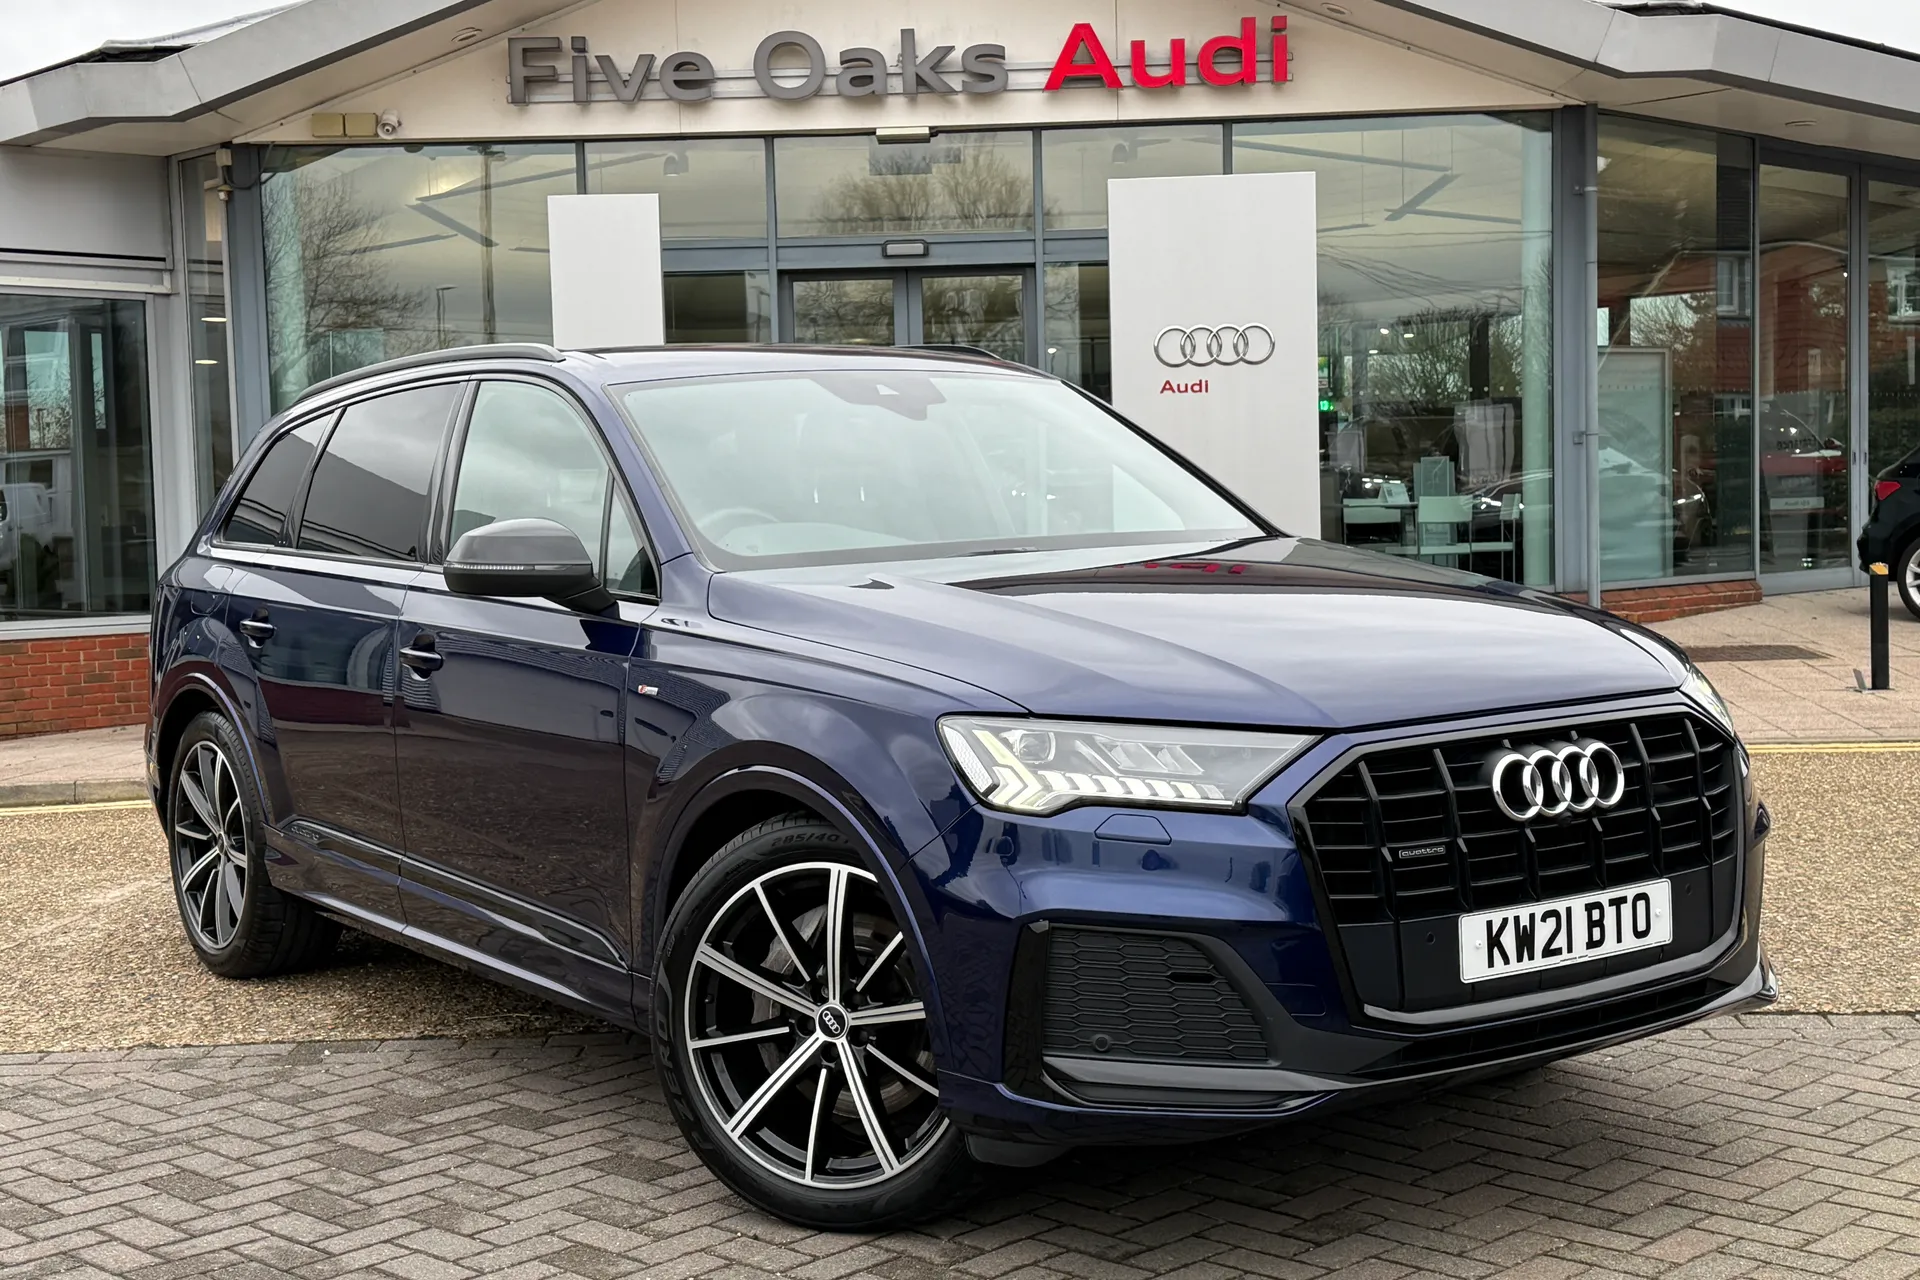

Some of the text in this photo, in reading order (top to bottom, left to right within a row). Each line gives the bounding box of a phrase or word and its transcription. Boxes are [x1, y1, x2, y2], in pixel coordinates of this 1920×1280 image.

[507, 15, 1288, 105] Five Oaks Audi
[1159, 378, 1209, 394] Audi
[1401, 846, 1445, 857] quattro
[1485, 891, 1652, 969] KW21 BTO
[656, 1014, 694, 1122] ZERO
